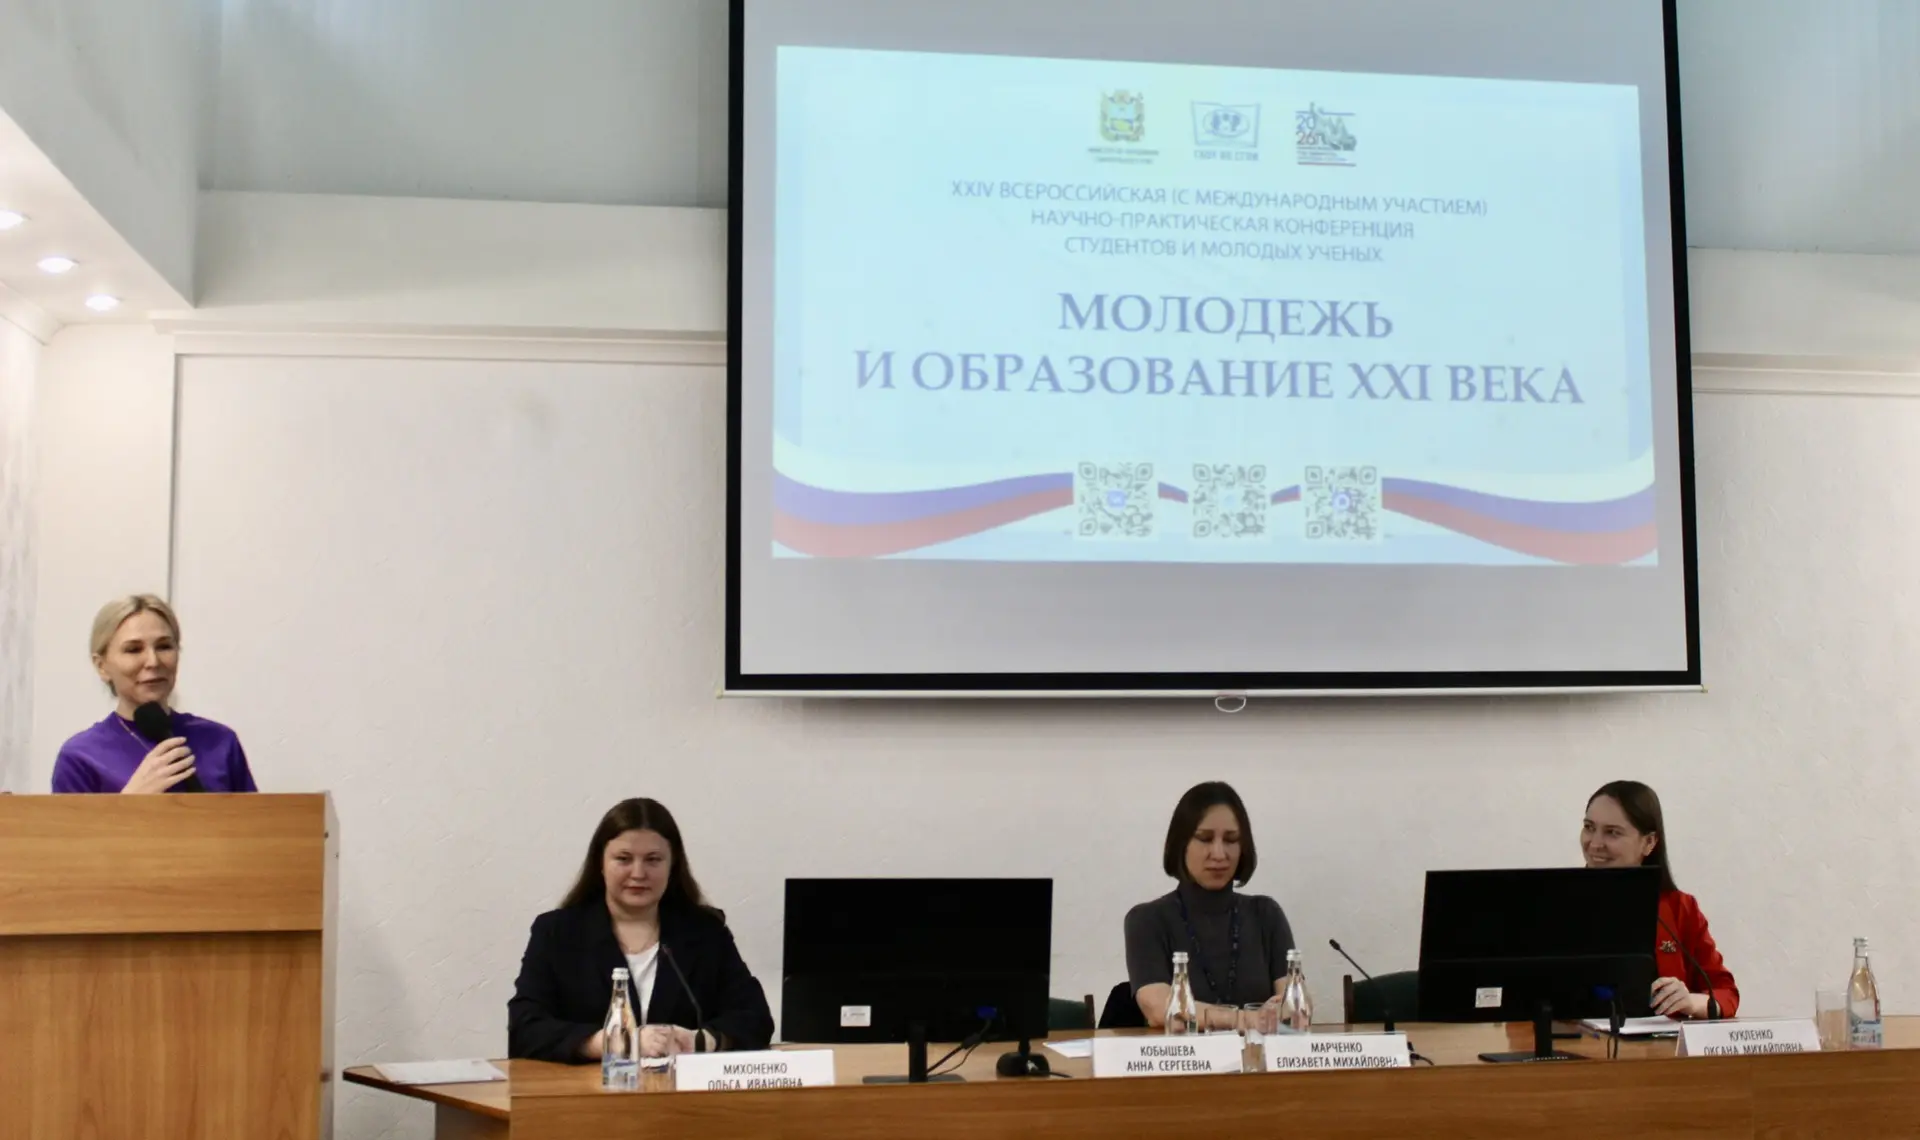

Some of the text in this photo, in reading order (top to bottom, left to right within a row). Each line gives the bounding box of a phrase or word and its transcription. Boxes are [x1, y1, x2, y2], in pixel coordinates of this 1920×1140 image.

[952, 179, 994, 198] XXIV
[999, 181, 1166, 203] ВСЕРОССИЙСКАЯ
[1195, 189, 1377, 211] МЕЖДУНАРОДНЫМ
[1382, 197, 1488, 217] УЧАСТИЕМ)
[1031, 210, 1414, 240] НАУЧНО-ПРАКТИЧЕСКАЯ КОНФЕРЕНЦИЯ
[1064, 236, 1384, 263] СТУДЕНТОВ И МОЛОДЫХ УЧЕНЫХ
[1057, 291, 1393, 343] МОЛОДЕЖЬ
[853, 349, 1585, 406] И ОБРАЗОВАНИЕ XXI ВЕКА
[1140, 1045, 1196, 1057] КОБЫШЕВА
[1311, 1041, 1363, 1053] МАРЧЕНКО
[723, 1062, 788, 1076] МИХОНЕНКО
[1126, 1059, 1212, 1072] АННА СЕРГЕЕВНА
[1276, 1055, 1398, 1068] ЕЛИЗАВЕТА МИХАЙЛОВНА
